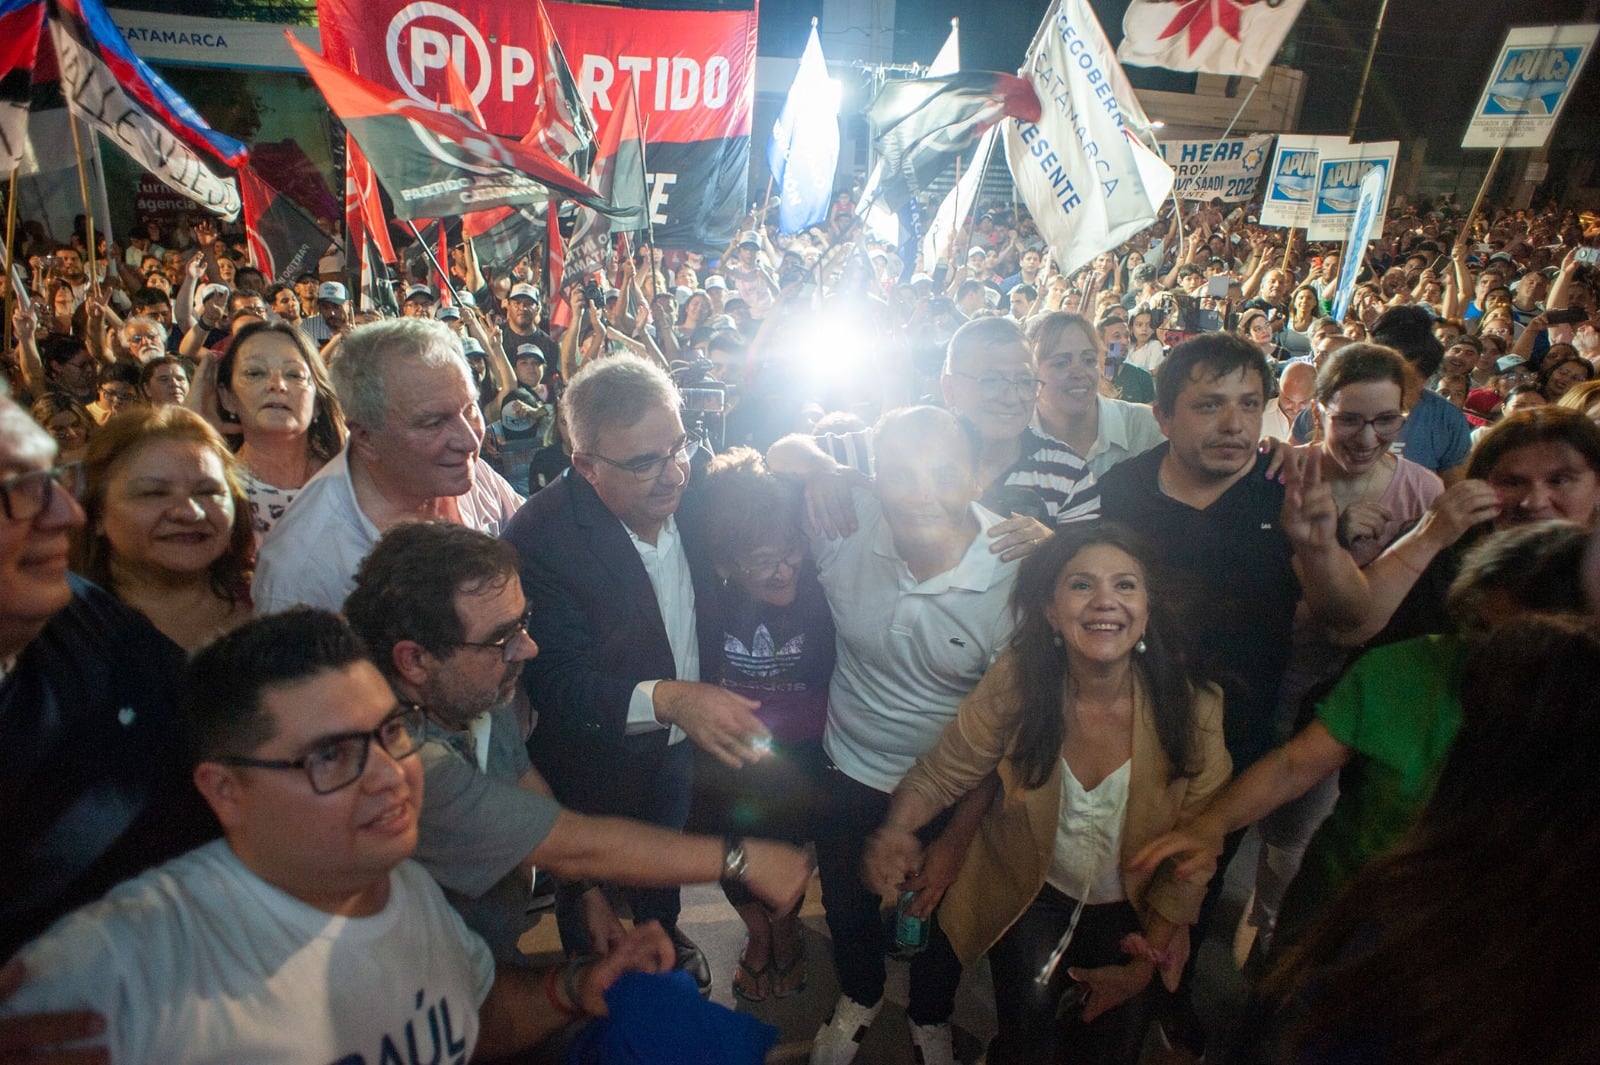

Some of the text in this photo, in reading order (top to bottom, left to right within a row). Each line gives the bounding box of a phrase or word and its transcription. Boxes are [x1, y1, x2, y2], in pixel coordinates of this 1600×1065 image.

[410, 26, 730, 112] PI PRTIDO
[1056, 9, 1129, 142] CEGOBERN
[137, 182, 174, 193] Turn
[1015, 117, 1082, 215] RESENTE
[1280, 152, 1319, 176] APUN
[1324, 161, 1375, 188] APUN
[138, 197, 197, 212] agencia
[330, 988, 466, 1065] AÚL
